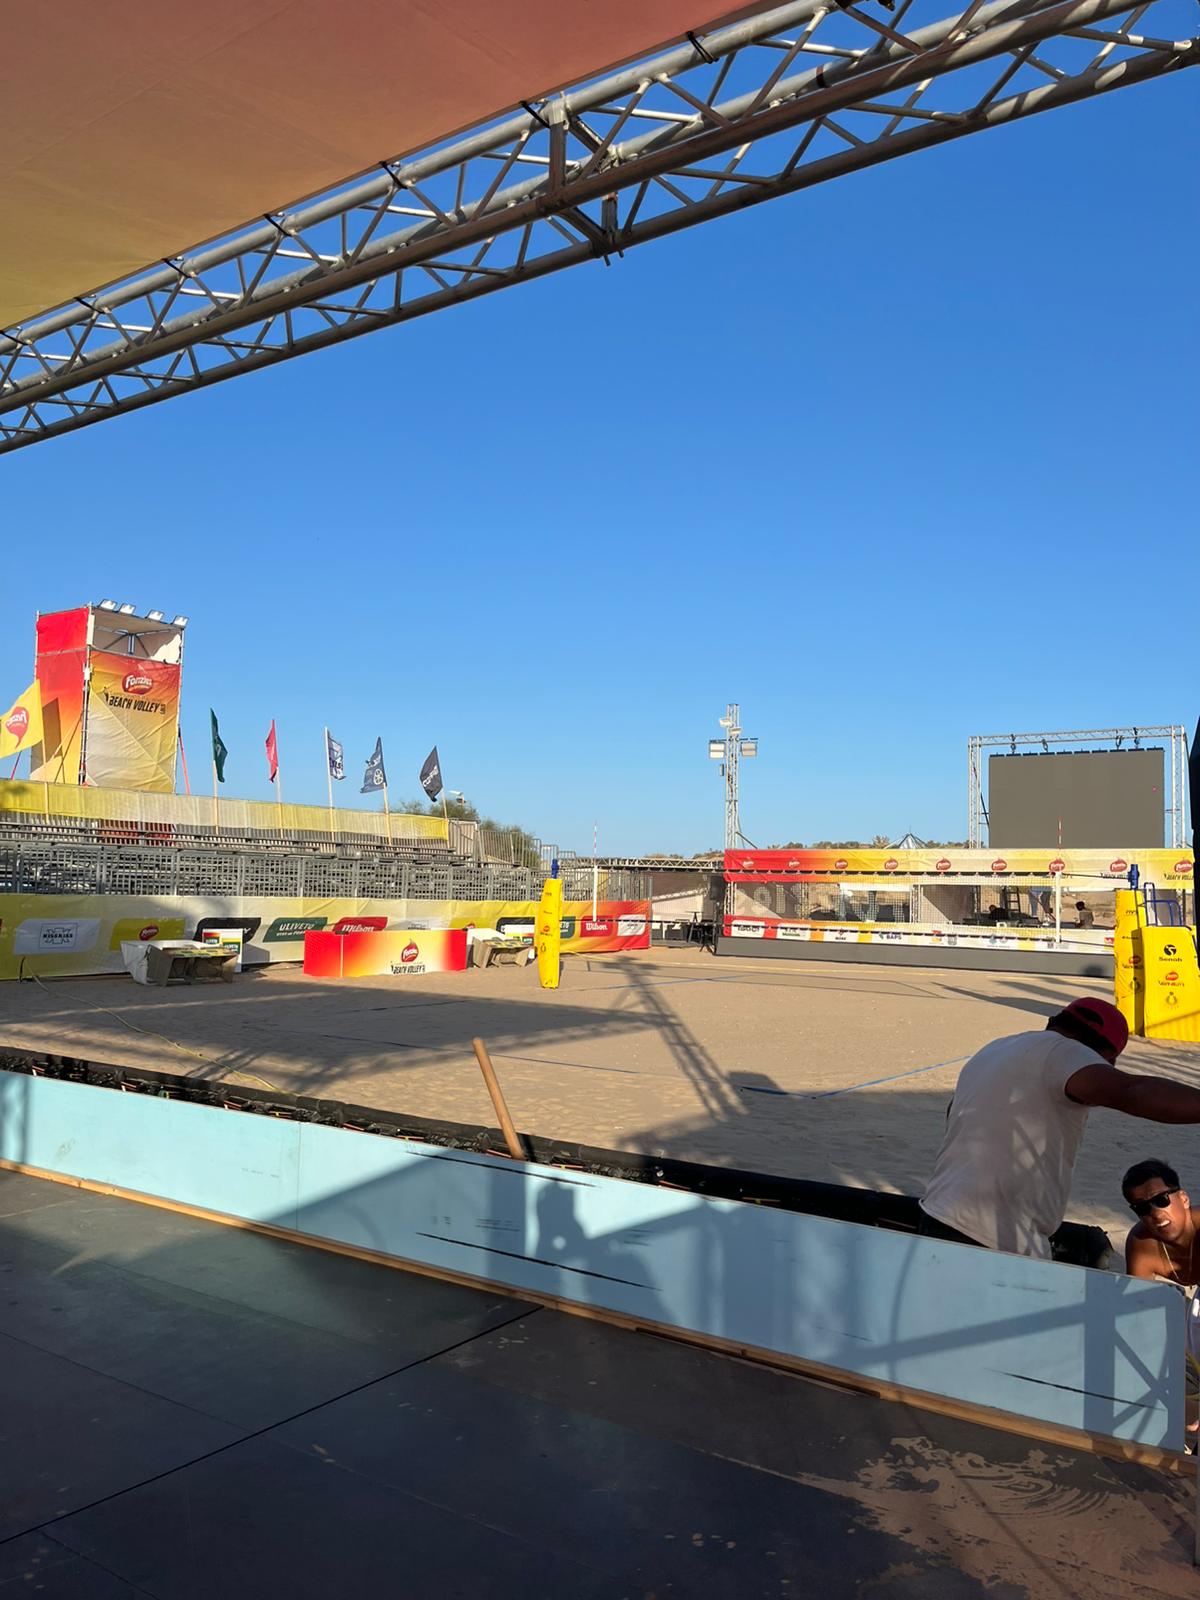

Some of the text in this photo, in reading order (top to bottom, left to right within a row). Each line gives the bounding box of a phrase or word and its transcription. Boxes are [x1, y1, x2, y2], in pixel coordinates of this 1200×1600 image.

[109, 695, 134, 710] BEACH
[133, 699, 160, 713] VOLLEY
[585, 922, 608, 931] Wilson
